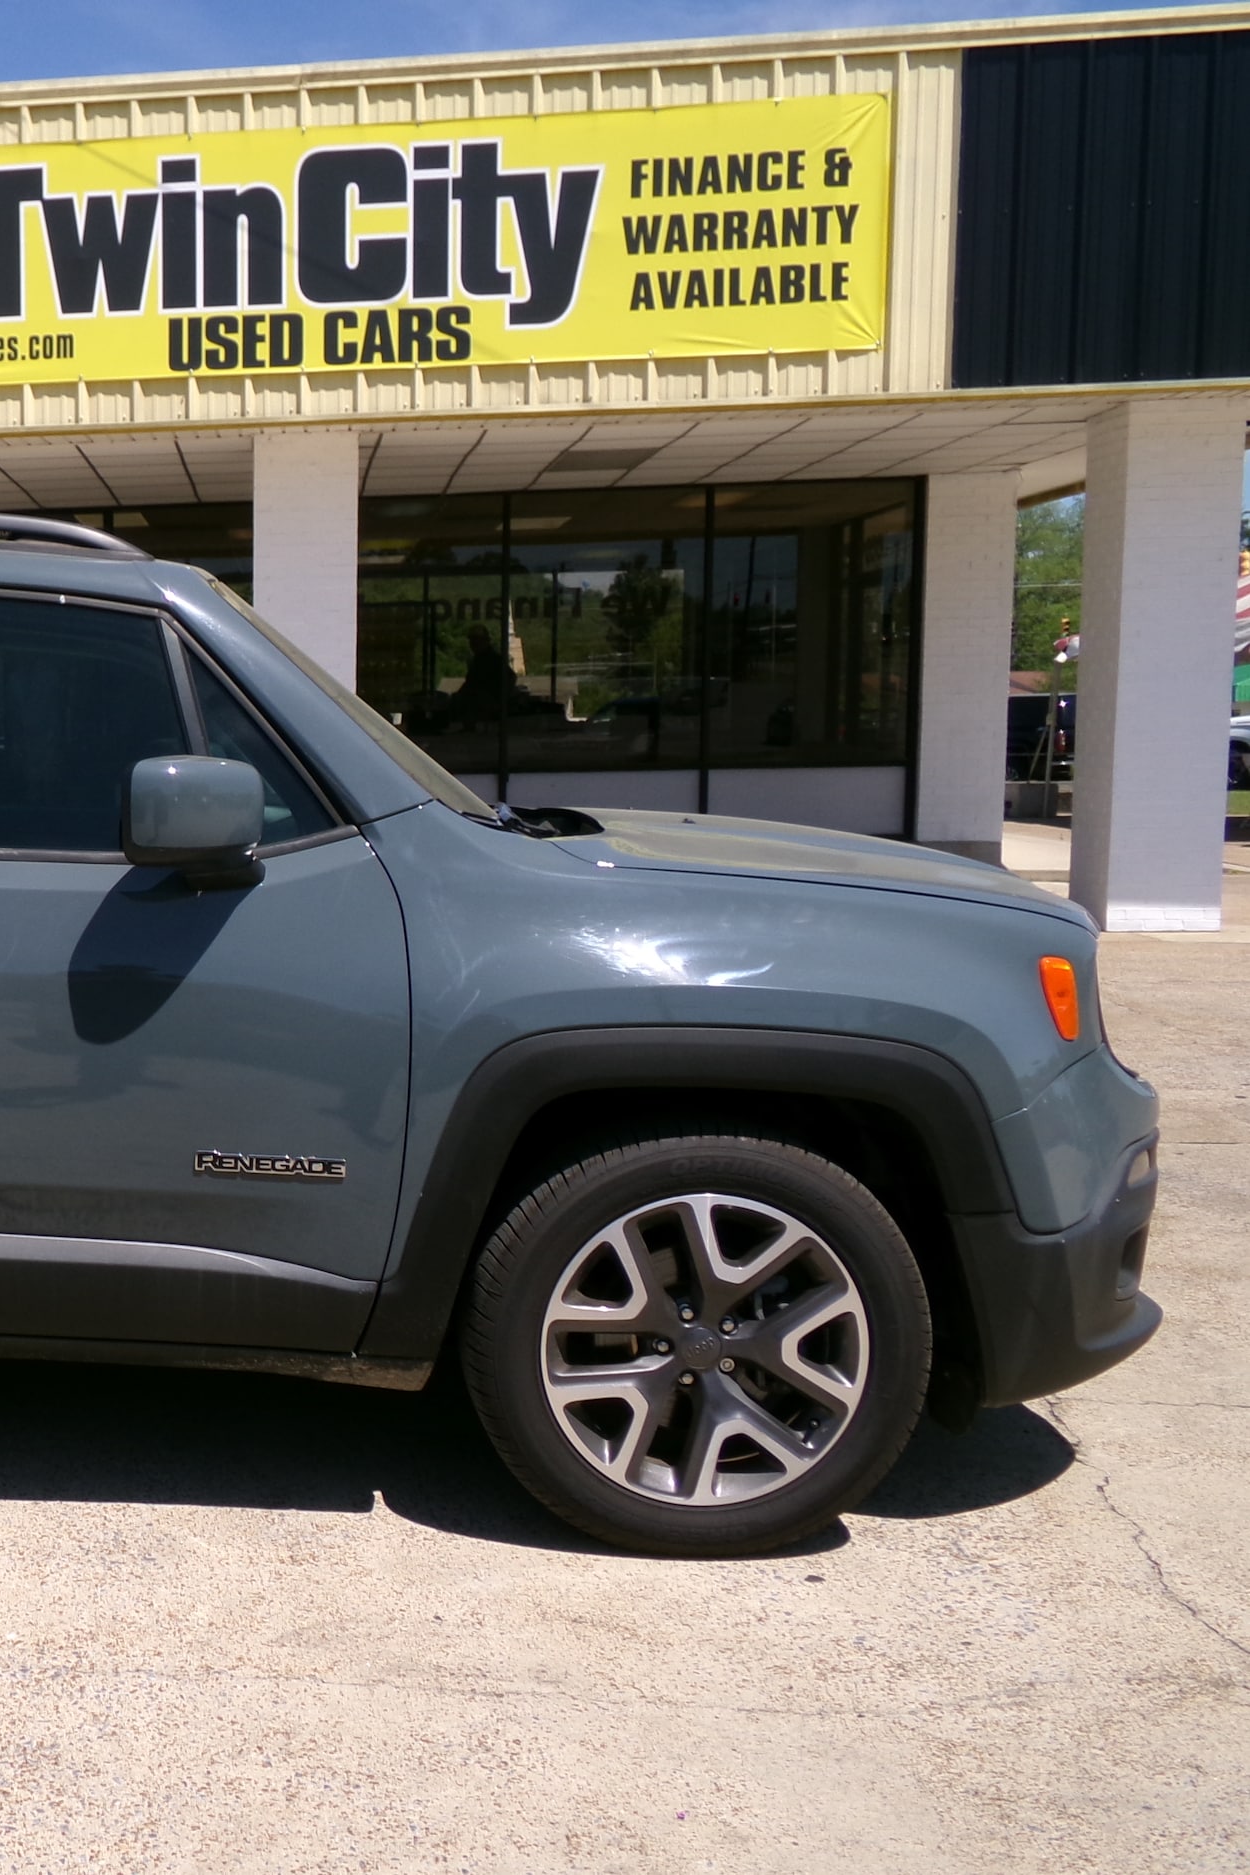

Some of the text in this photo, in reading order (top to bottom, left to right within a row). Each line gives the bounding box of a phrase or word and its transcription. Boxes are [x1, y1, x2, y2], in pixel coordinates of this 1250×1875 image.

[630, 147, 853, 199] FINANCE &
[622, 204, 859, 255] WARRANTY
[629, 261, 849, 311] AVAILABLE
[168, 306, 472, 372] USED CARS
[194, 1149, 347, 1178] RENEGADE
